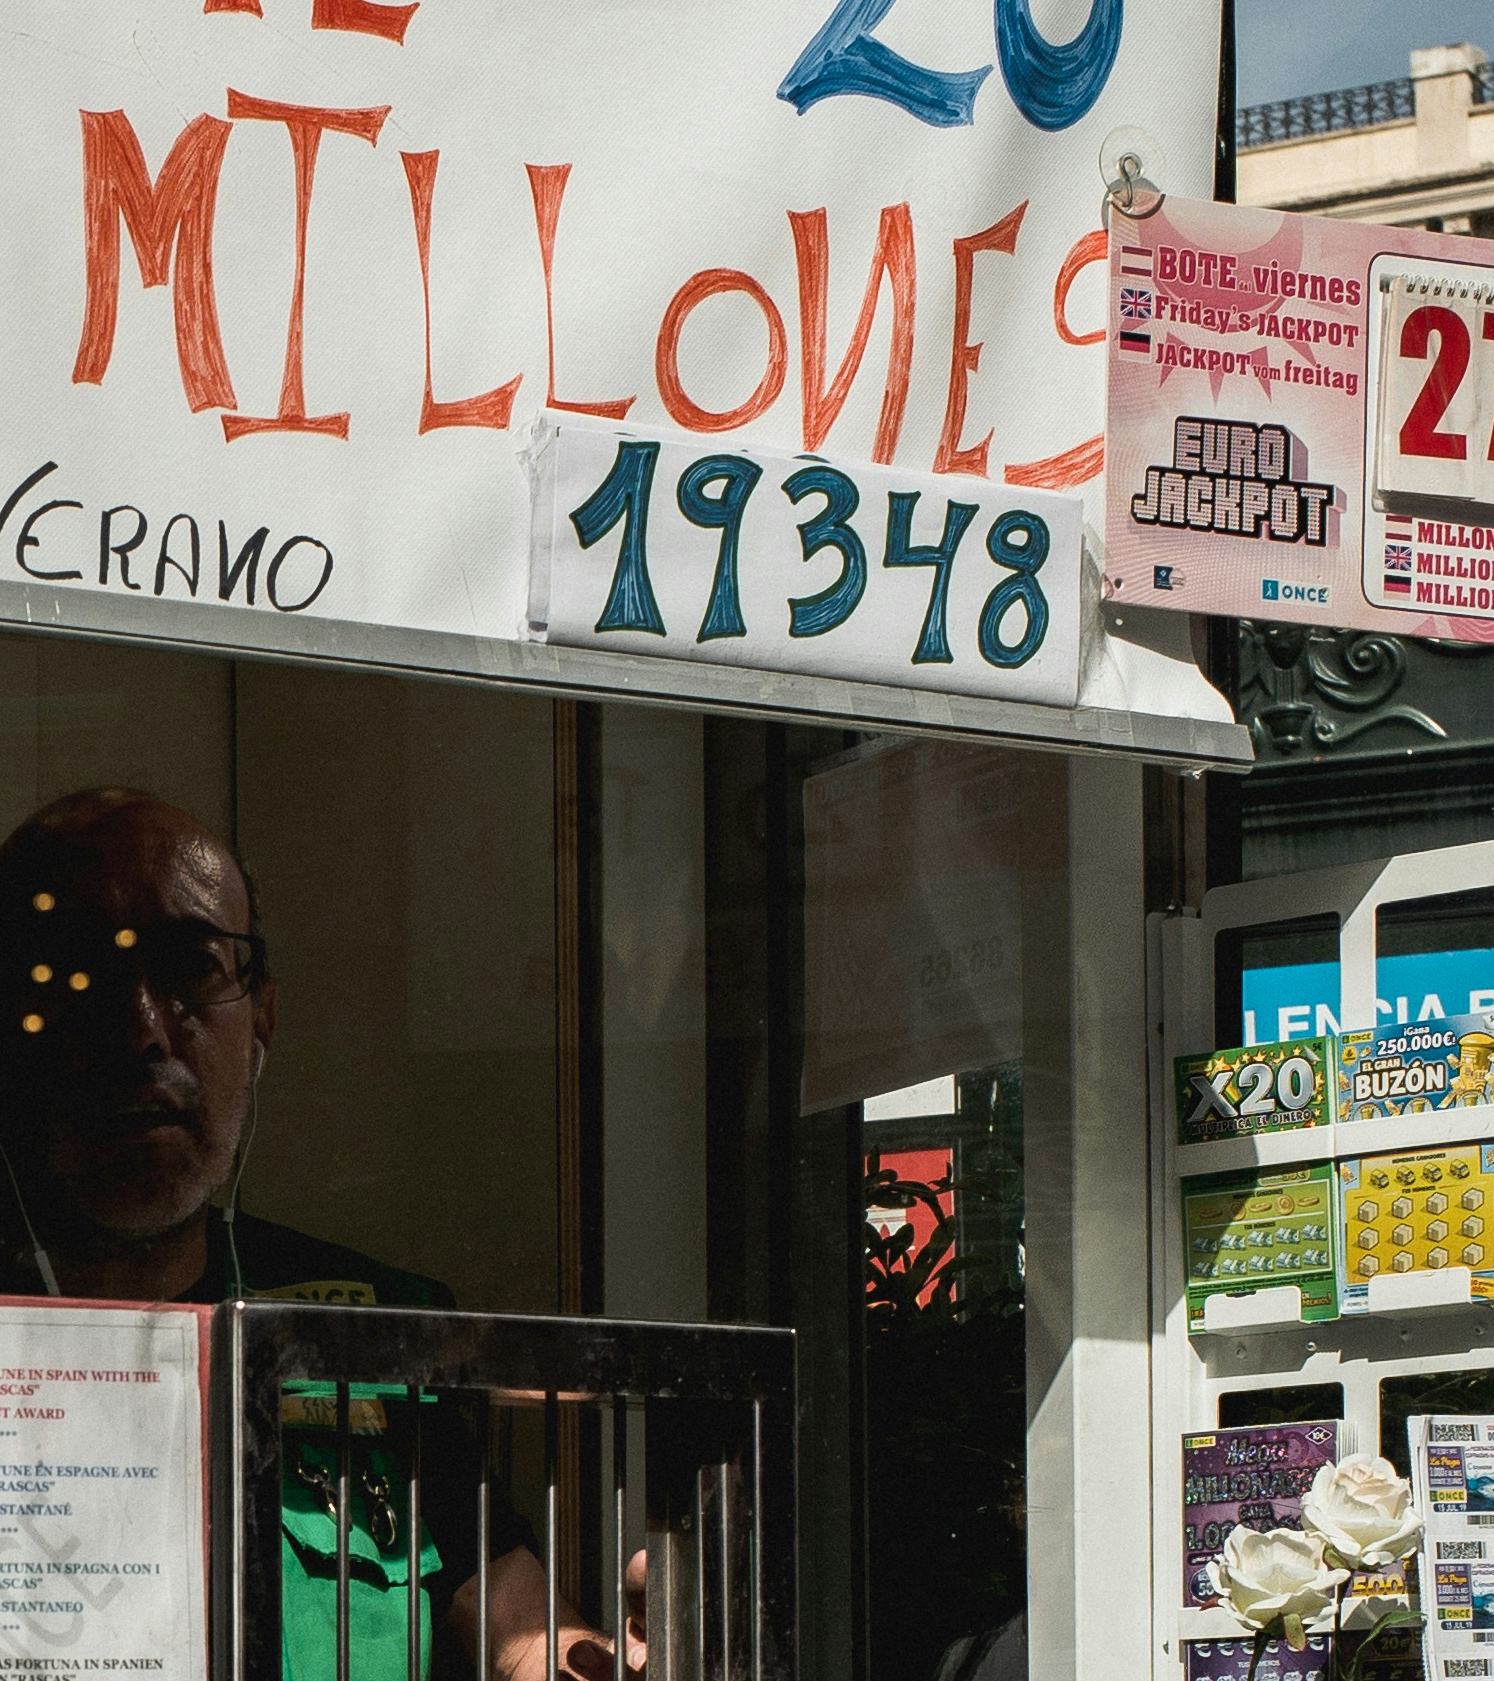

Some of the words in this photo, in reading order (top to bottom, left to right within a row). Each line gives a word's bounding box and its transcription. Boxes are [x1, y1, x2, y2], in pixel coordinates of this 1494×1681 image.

[1158, 246, 1238, 290] BOTE
[1253, 261, 1361, 306] viernes
[1154, 295, 1252, 334] Friday's
[1257, 311, 1359, 348] JACKPOT
[1155, 343, 1251, 375] JACKPOT
[1253, 365, 1281, 381] vom
[1283, 363, 1359, 396] freitag
[1175, 420, 1288, 479] EURO
[1133, 471, 1329, 543] JACKPOT
[568, 440, 1054, 670] 19348
[1281, 585, 1329, 603] ONCE
[1187, 1057, 1316, 1122] X20
[1354, 1060, 1444, 1100] BUZÓN
[28, 1368, 44, 1380] IN
[46, 1369, 88, 1382] SPAIN
[90, 1370, 131, 1382] WITH
[133, 1371, 161, 1383] THE
[13, 1407, 65, 1420] AWARD
[56, 1466, 121, 1478] ESPAGNE
[122, 1466, 159, 1479] AVEC
[64, 1563, 119, 1575] SPAGNA
[15, 1659, 82, 1670] FORTUNA
[102, 1659, 164, 1670] SPANIEN
